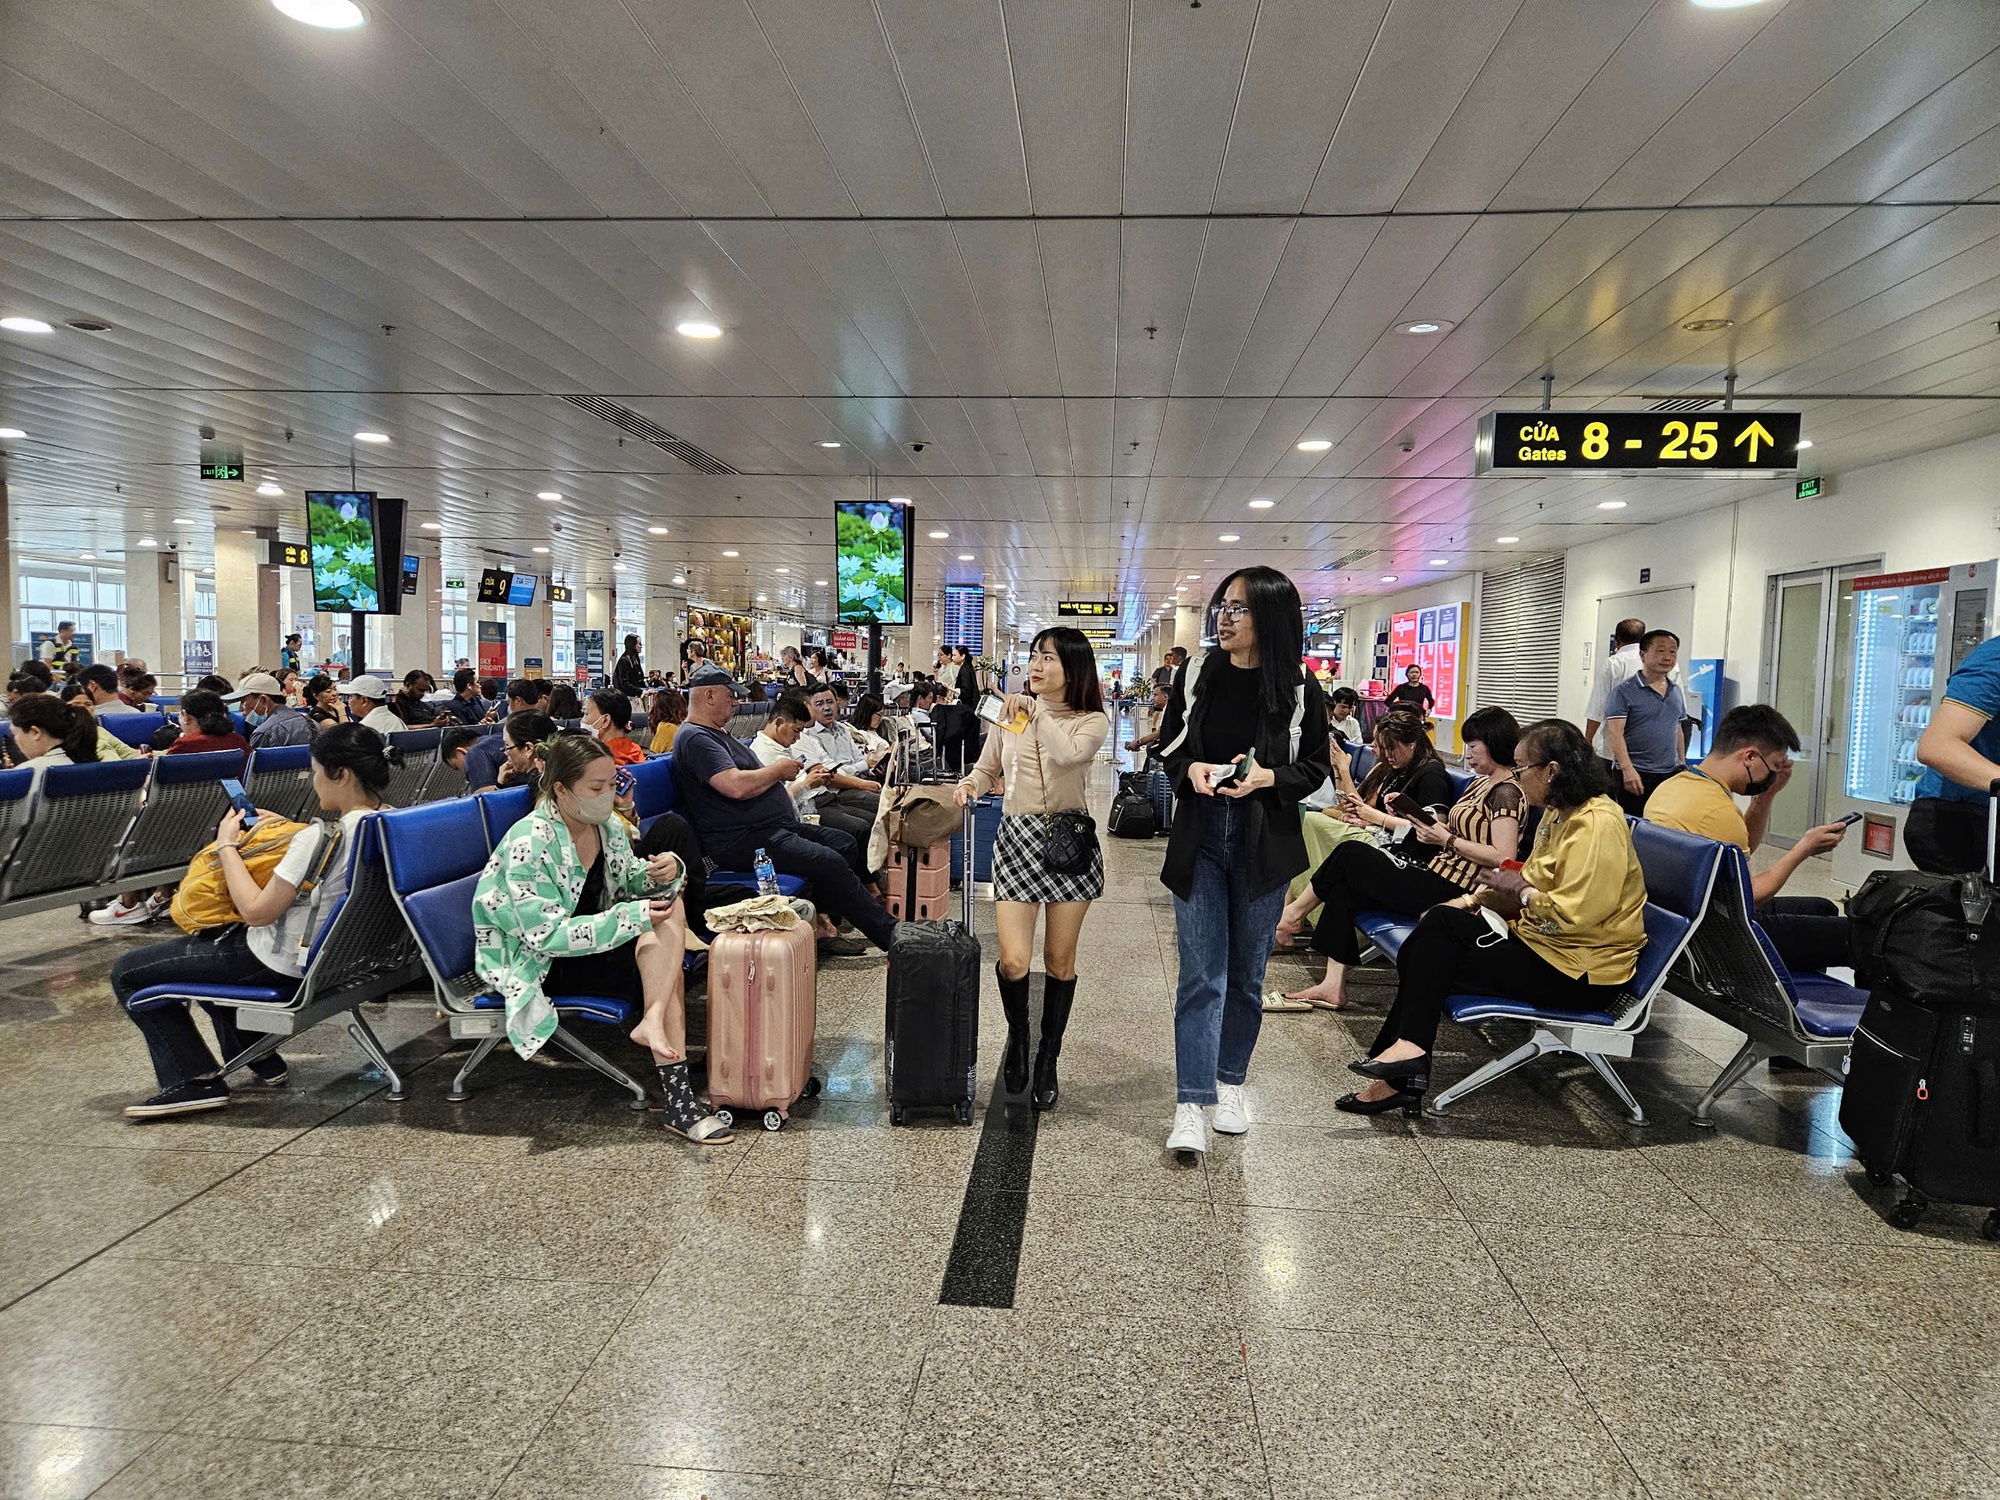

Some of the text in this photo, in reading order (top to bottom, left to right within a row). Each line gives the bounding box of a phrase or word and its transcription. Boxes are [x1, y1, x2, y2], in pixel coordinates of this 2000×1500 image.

[1519, 421, 1560, 442] CỬA
[1581, 421, 1610, 460] 8
[1659, 420, 1719, 460] 25
[1518, 446, 1567, 461] Gates
[1801, 480, 1815, 490] EXIT
[300, 549, 308, 565] 8
[498, 579, 506, 596] 9
[560, 589, 566, 600] 9
